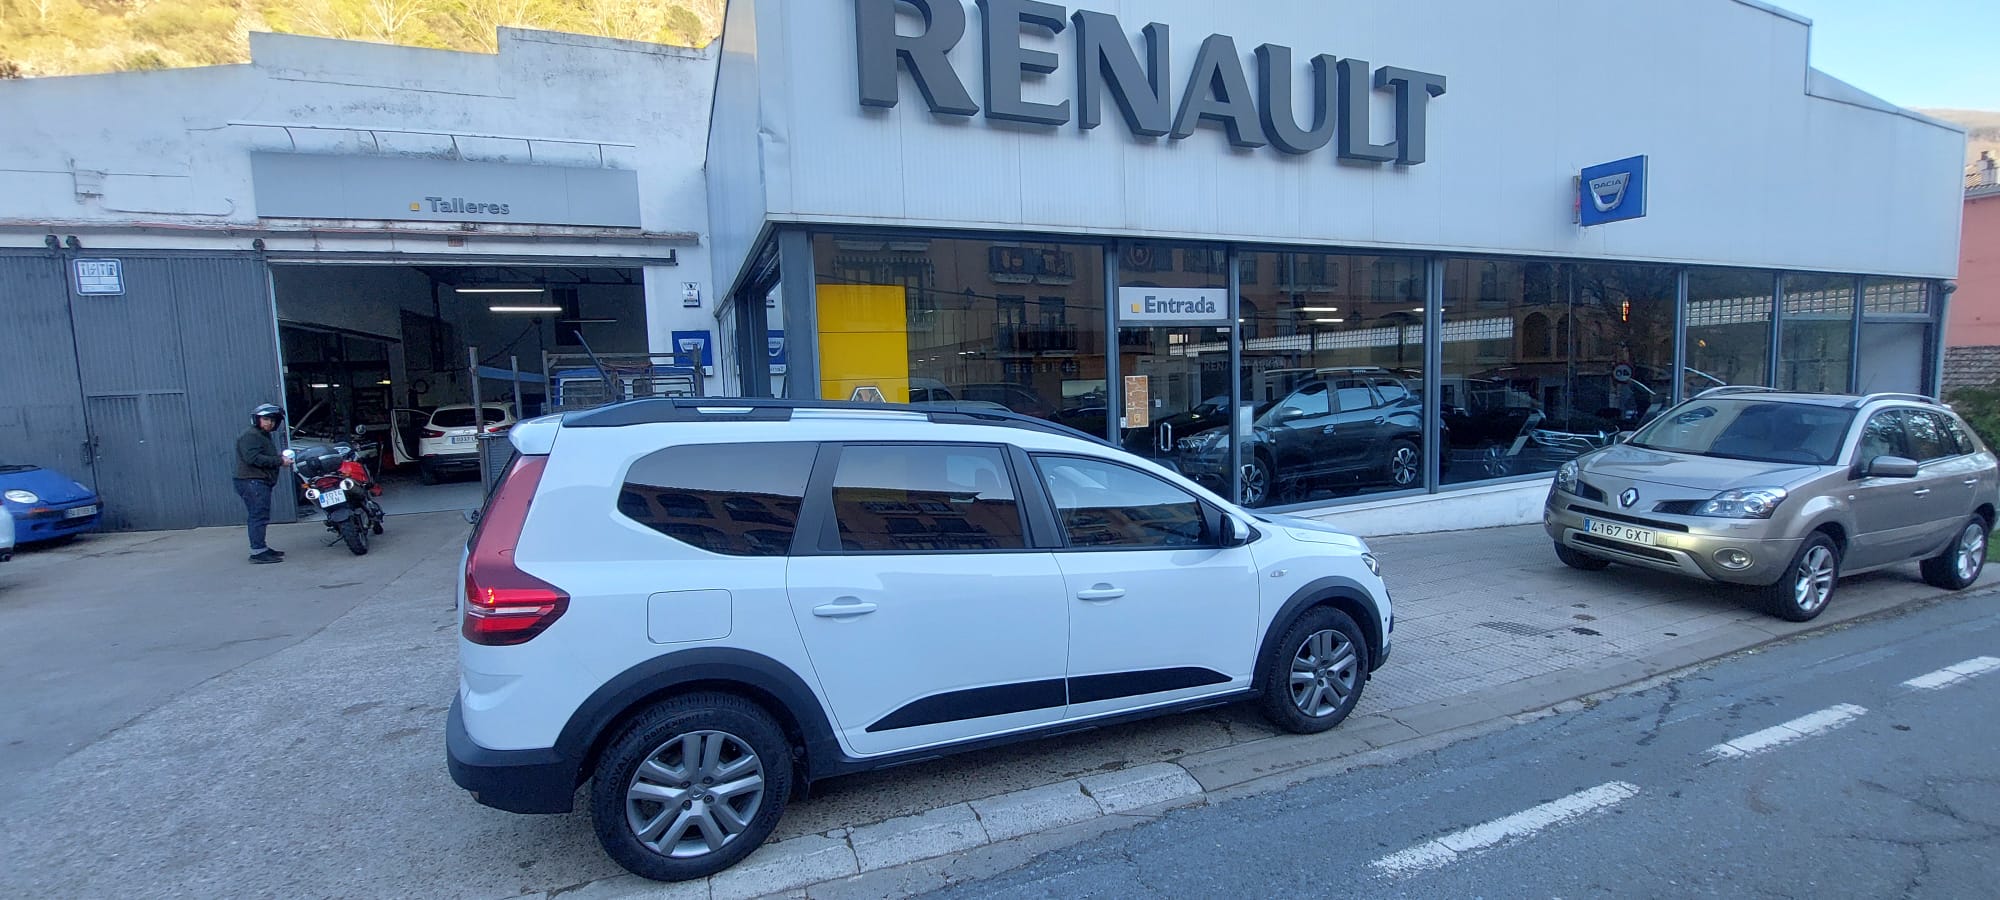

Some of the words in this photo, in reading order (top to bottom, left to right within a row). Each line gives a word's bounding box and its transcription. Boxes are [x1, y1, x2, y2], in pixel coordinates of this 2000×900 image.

[855, 0, 1447, 166] RENAULT
[1593, 178, 1622, 190] DACIA
[425, 196, 510, 215] Talleres
[1144, 295, 1216, 314] Entrada
[1591, 522, 1622, 537] 4167
[1625, 528, 1651, 542] GXT
